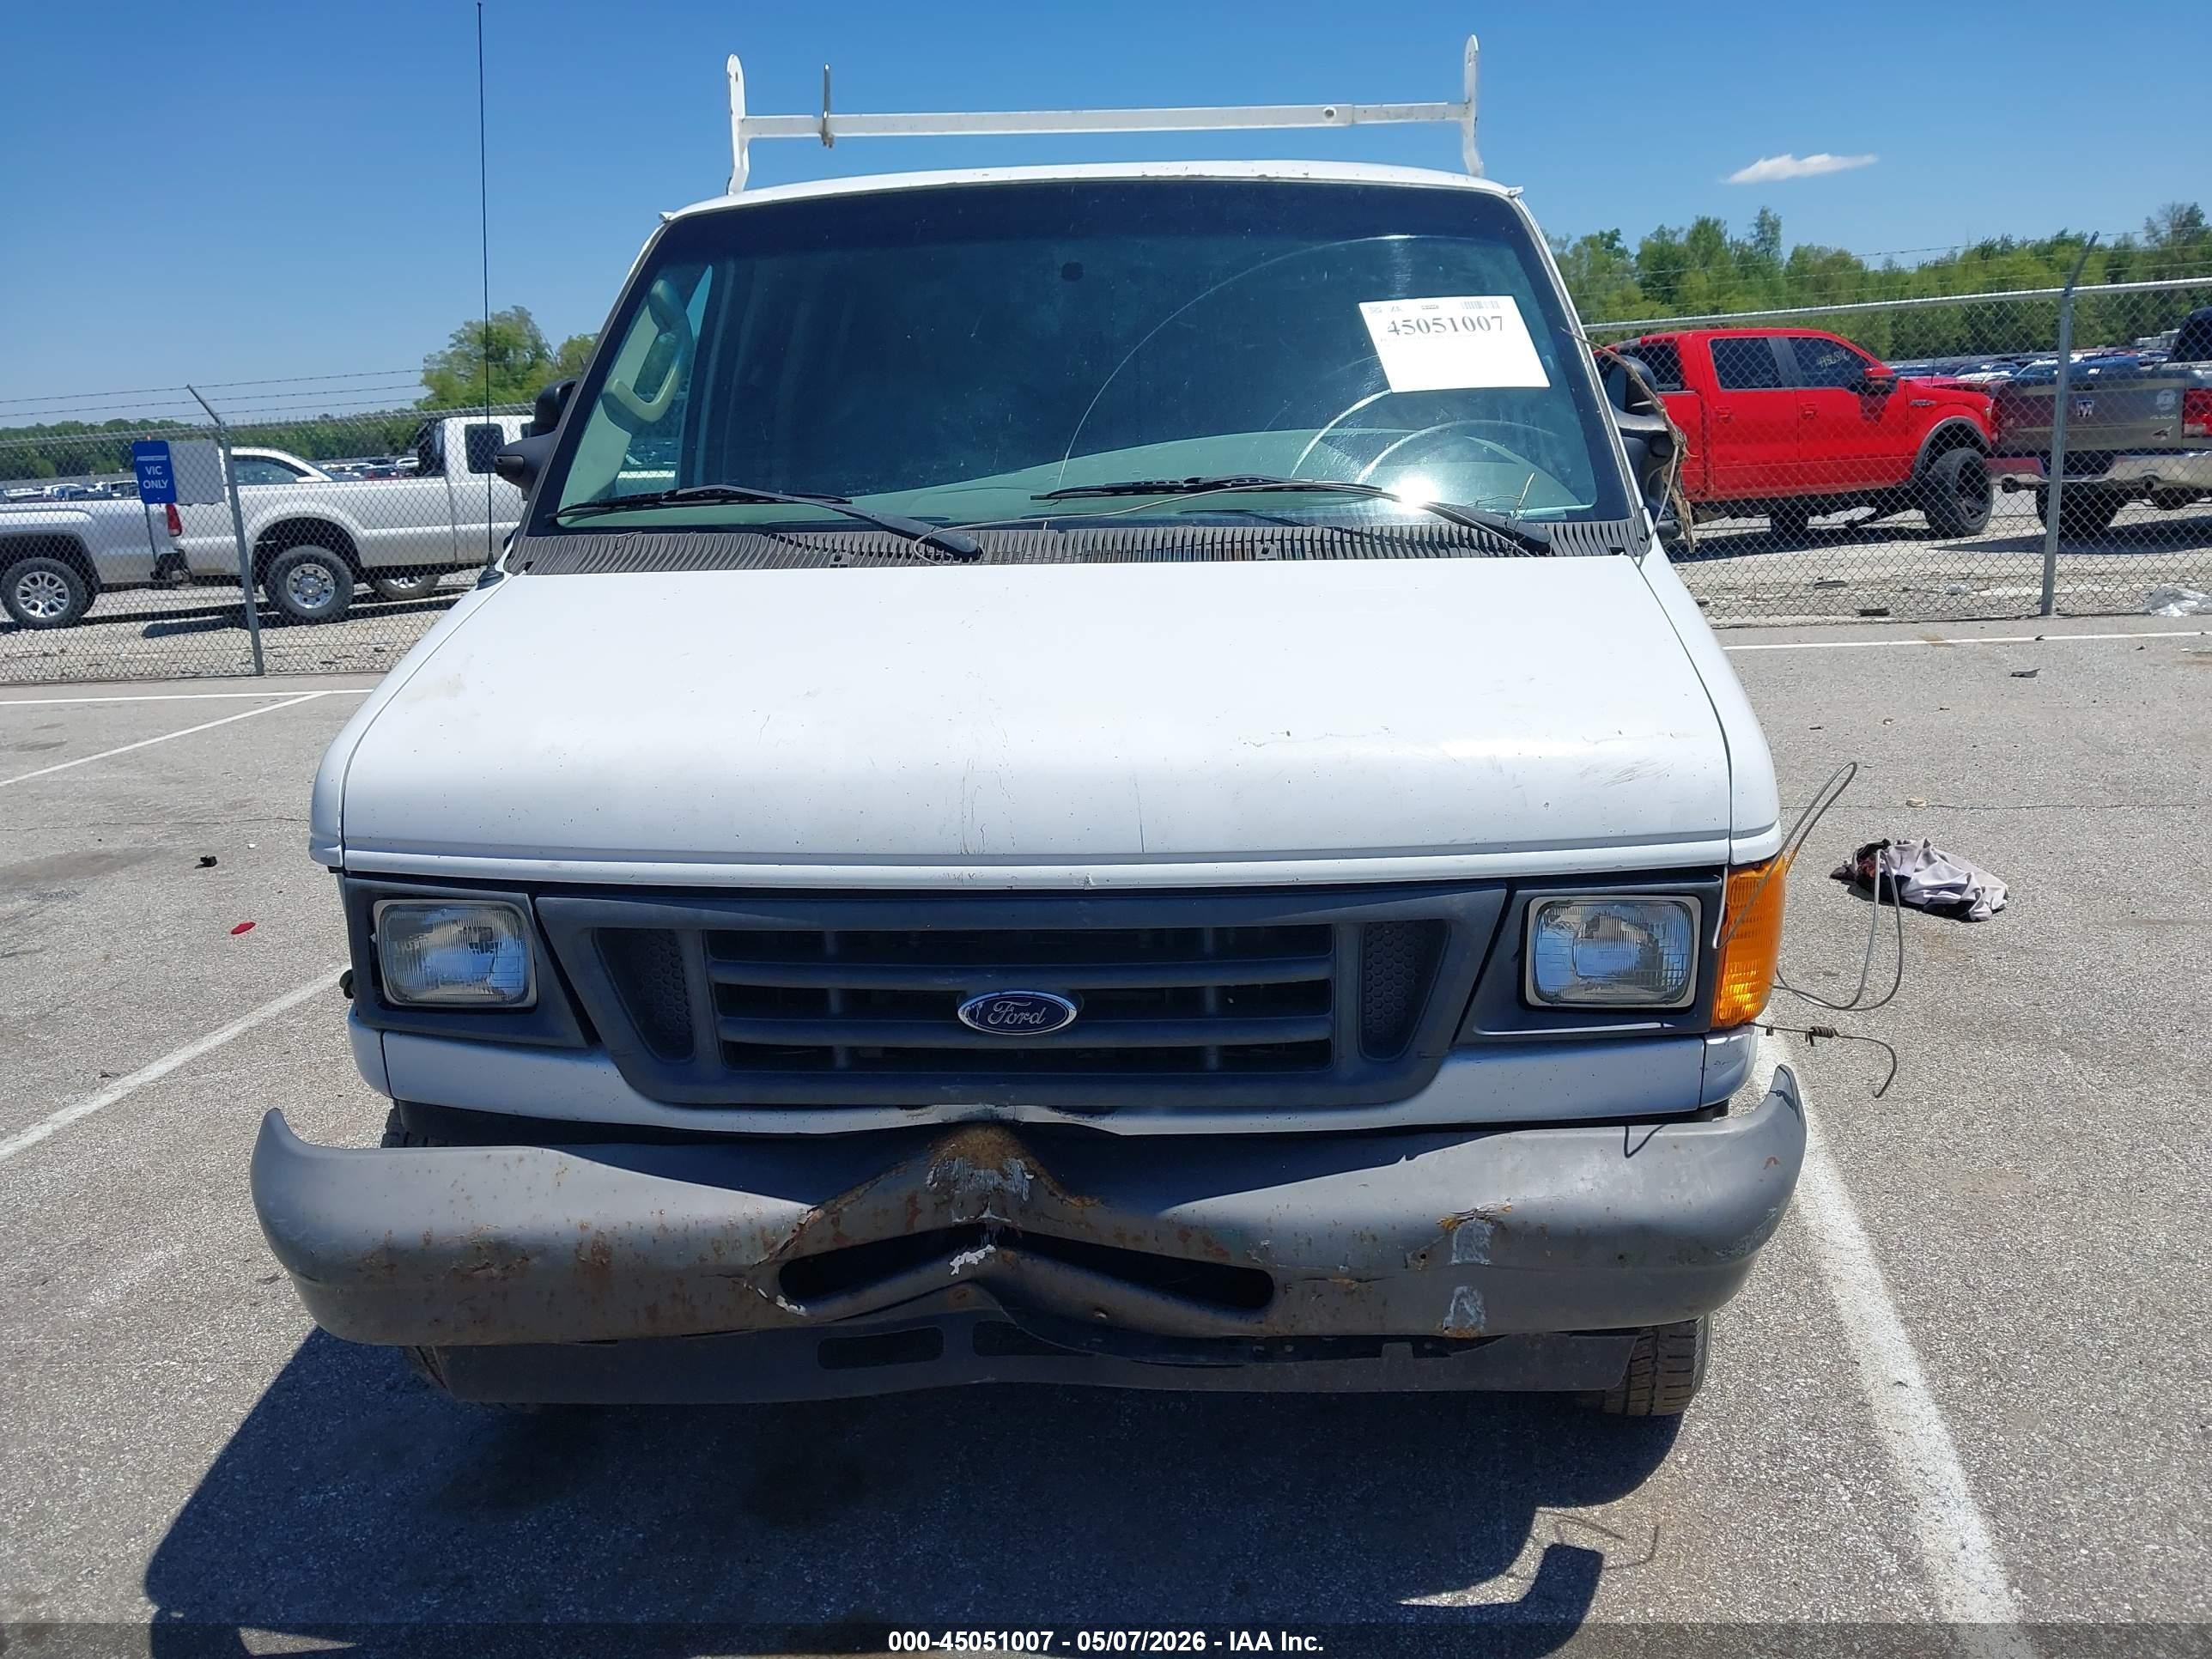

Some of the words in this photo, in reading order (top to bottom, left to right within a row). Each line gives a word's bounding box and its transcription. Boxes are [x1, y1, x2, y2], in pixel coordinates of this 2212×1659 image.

[1388, 315, 1504, 336] 45051007
[144, 465, 163, 476] VIC
[143, 479, 168, 489] ONLY
[988, 1000, 1048, 1024] Ford
